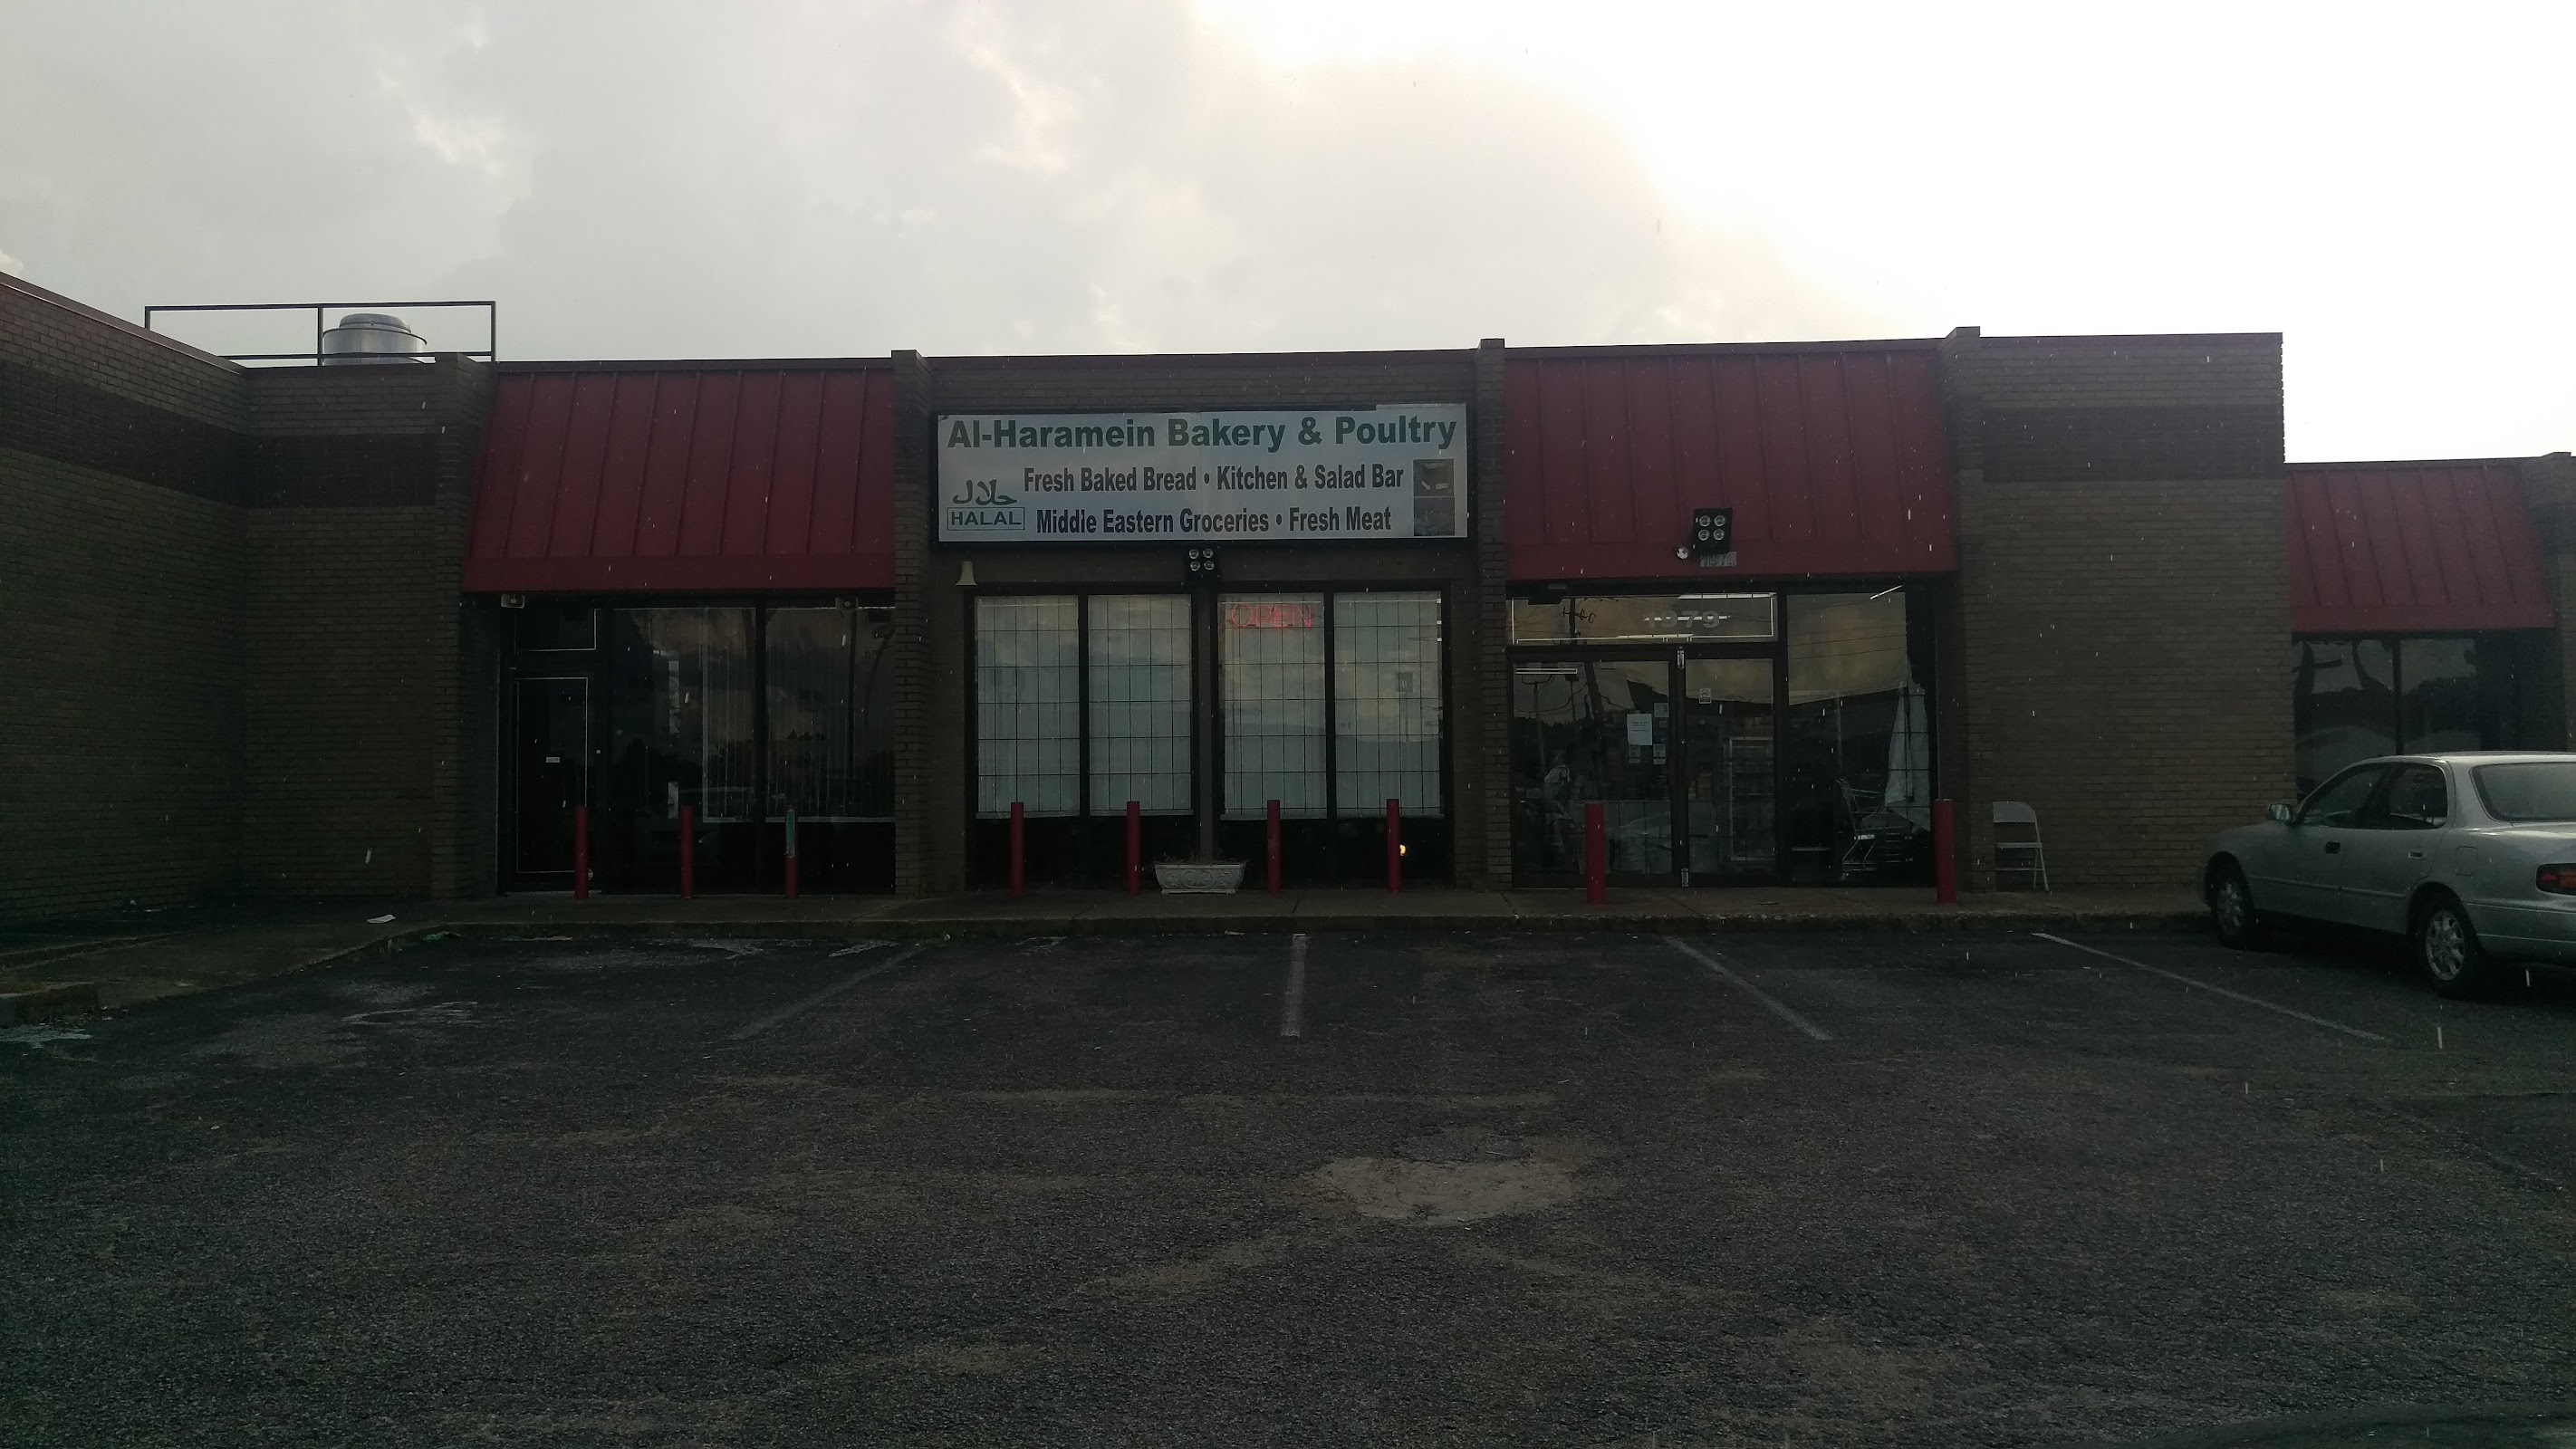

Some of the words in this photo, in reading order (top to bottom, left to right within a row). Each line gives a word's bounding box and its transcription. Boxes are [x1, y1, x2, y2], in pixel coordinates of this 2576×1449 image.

[947, 418, 1155, 448] Al-Haramein
[1168, 417, 1285, 453] Bakery
[1297, 417, 1322, 446] &
[1335, 415, 1456, 450] Poultry
[1024, 467, 1074, 492] Fresh
[1081, 467, 1137, 492] Baked
[1143, 466, 1196, 491] Bread
[1217, 465, 1288, 490] Kitchen
[1294, 465, 1308, 489] &
[1314, 464, 1365, 489] Salad
[1371, 464, 1404, 487] Bar
[952, 479, 1017, 505] حلال
[951, 511, 1022, 525] HALAL
[1036, 509, 1097, 533] Middle
[1103, 509, 1174, 533] Eastern
[1179, 507, 1269, 533] Groceries
[1290, 507, 1340, 531] Fresh
[1346, 506, 1391, 530] Meat
[1231, 602, 1312, 628] OPEN
[1643, 610, 1720, 629] 1979
